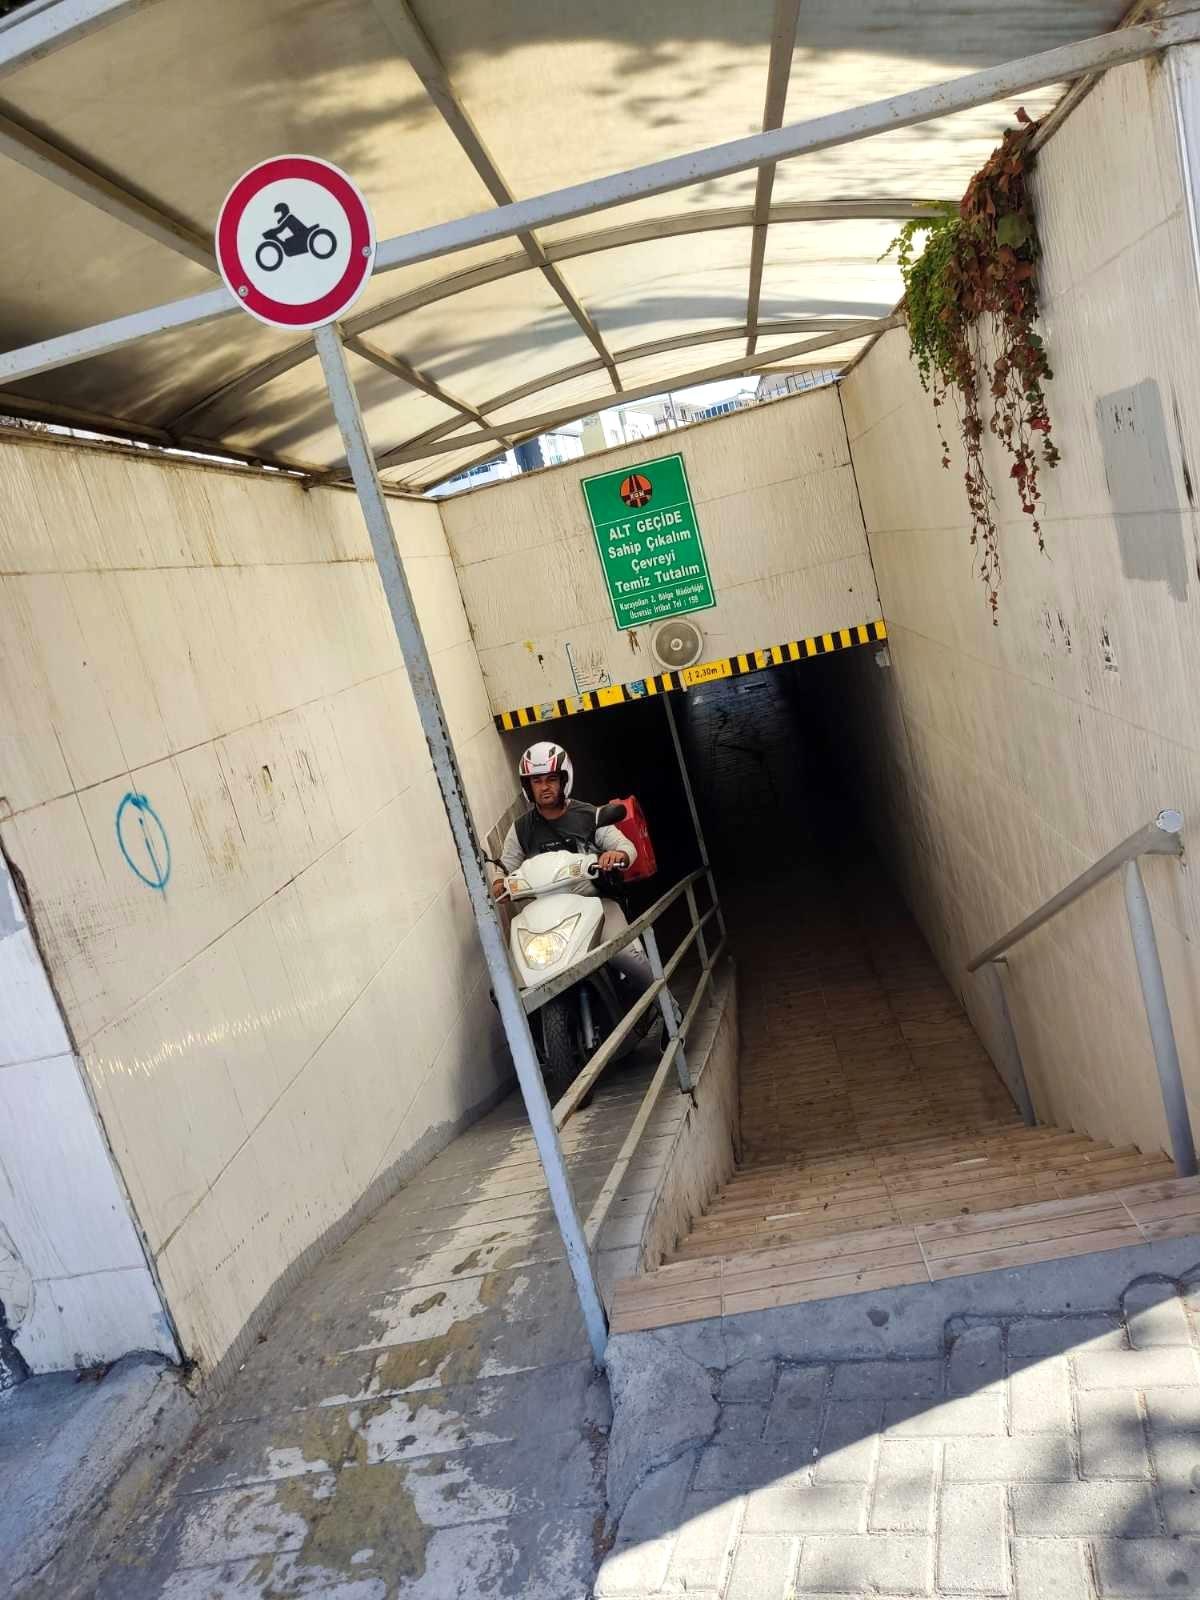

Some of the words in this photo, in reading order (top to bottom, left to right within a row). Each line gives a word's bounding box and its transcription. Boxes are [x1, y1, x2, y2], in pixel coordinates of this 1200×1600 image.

[609, 523, 631, 541] ALT
[636, 510, 683, 532] GEÇİDE
[608, 541, 642, 559] Sahip
[646, 528, 692, 551] Çıkalım
[631, 549, 676, 574] Çevreyi
[615, 575, 651, 594] Temiz
[654, 563, 700, 584] Tutalım
[651, 595, 656, 603] 2.
[673, 600, 682, 608] Tel
